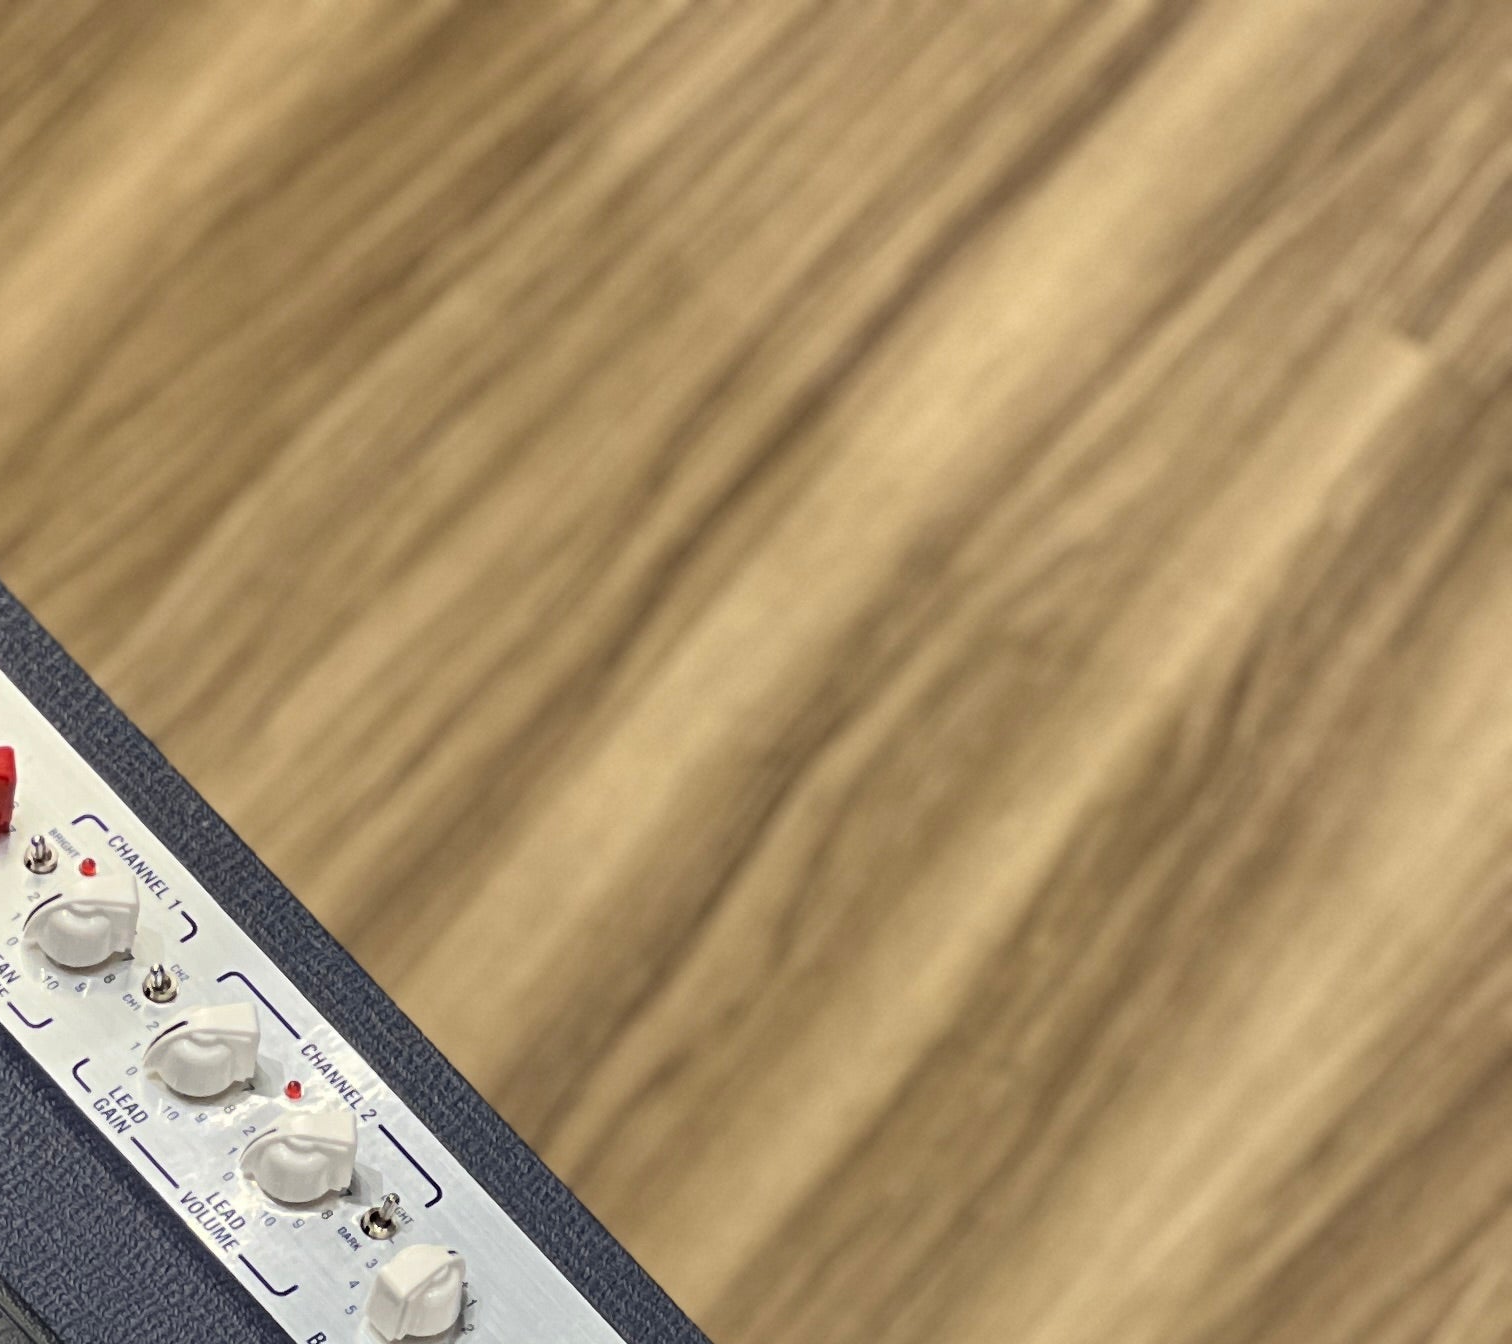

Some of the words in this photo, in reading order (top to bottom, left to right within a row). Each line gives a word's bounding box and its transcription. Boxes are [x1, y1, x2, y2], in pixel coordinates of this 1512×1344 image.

[48, 827, 81, 858] BRIGHT
[108, 835, 170, 900] CHANNEL
[167, 899, 182, 910] 1
[171, 964, 190, 982] CH2
[122, 993, 142, 1012] CH1
[301, 1043, 365, 1110] CHANNEL
[360, 1108, 378, 1122] 2
[93, 1097, 133, 1134] GAIN
[108, 1085, 149, 1125] LEAD
[178, 1190, 241, 1253] VOLUME
[206, 1191, 248, 1231] LEAD
[337, 1226, 363, 1252] DARK
